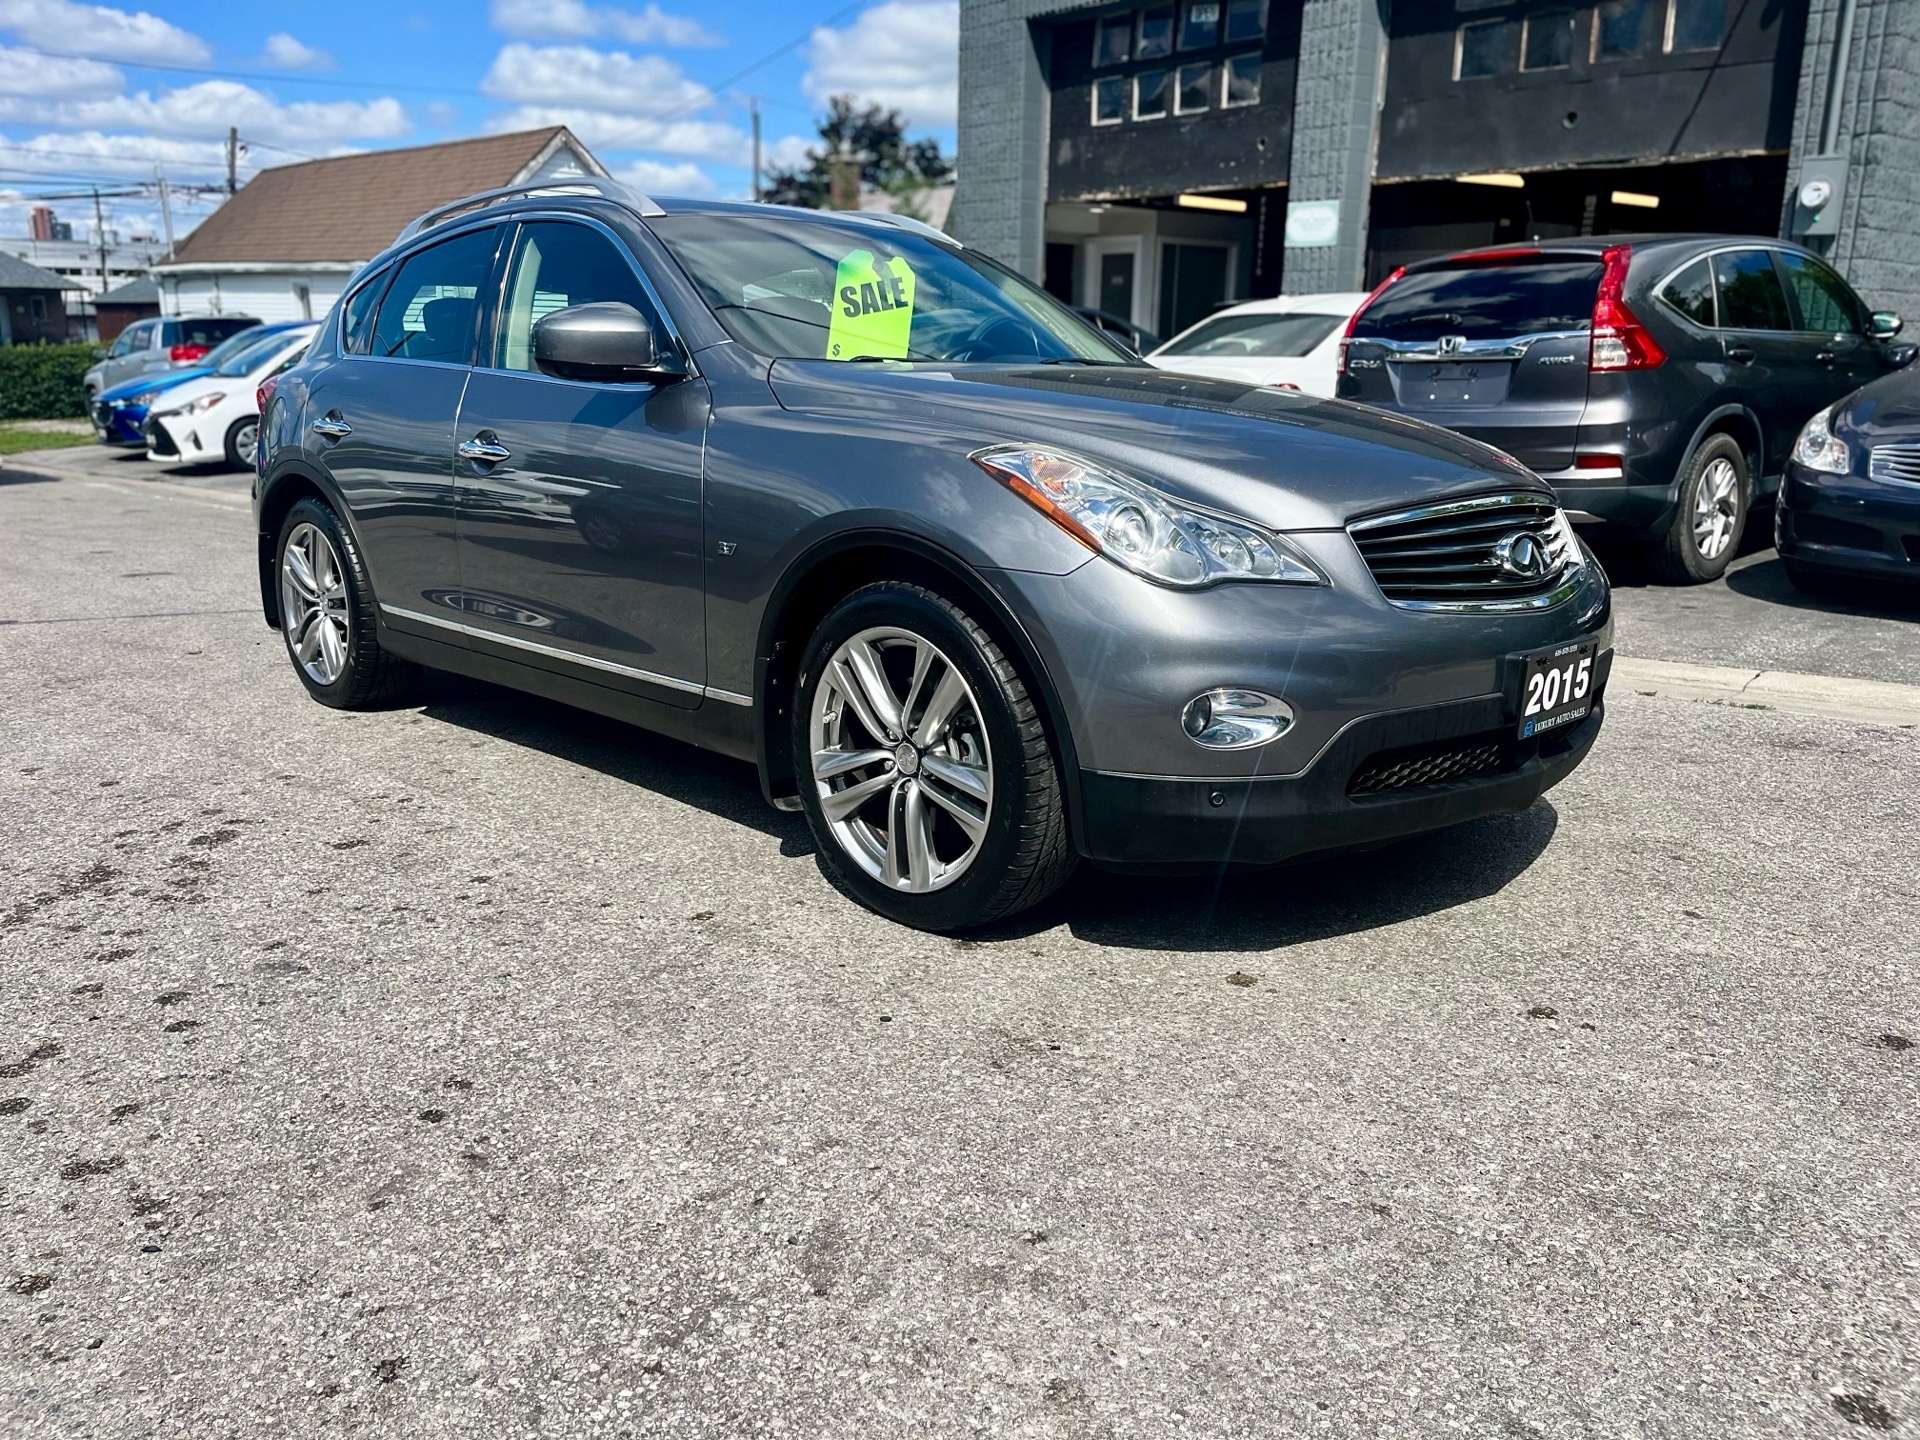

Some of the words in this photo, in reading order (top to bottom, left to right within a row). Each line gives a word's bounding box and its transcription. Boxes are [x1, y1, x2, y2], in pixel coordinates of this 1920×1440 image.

[840, 277, 909, 318] SALE
[832, 343, 841, 358] $
[1524, 657, 1592, 717] 2015
[1534, 717, 1556, 732] LUXURY
[1555, 711, 1571, 725] AUTO
[1570, 706, 1586, 719] SALES
